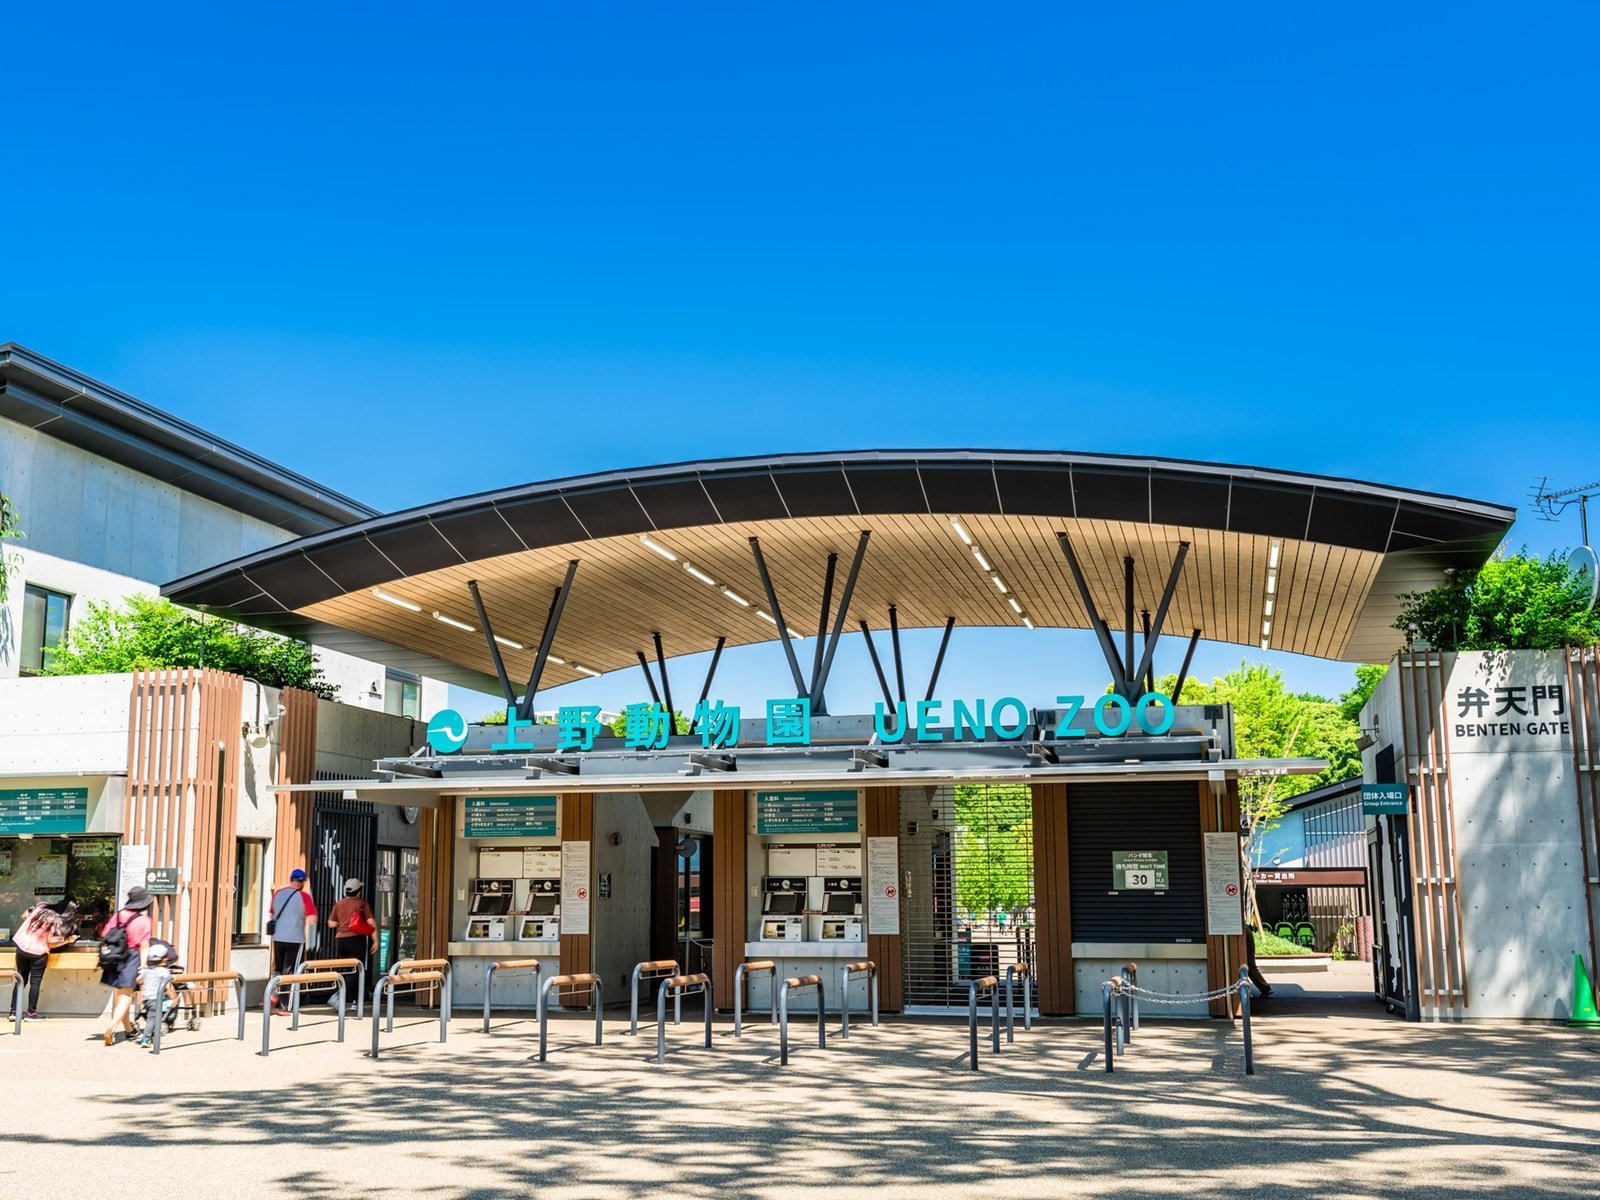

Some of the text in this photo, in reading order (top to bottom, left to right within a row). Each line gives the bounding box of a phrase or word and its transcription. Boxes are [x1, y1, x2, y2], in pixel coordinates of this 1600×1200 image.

[1457, 685, 1565, 718] 弁天門
[491, 698, 811, 751] 上野動物園
[875, 692, 1175, 743] UENO ZOO
[1455, 721, 1570, 738] BENTEN GATE
[1363, 791, 1402, 800] 団体入場口
[1132, 874, 1148, 885] 30
